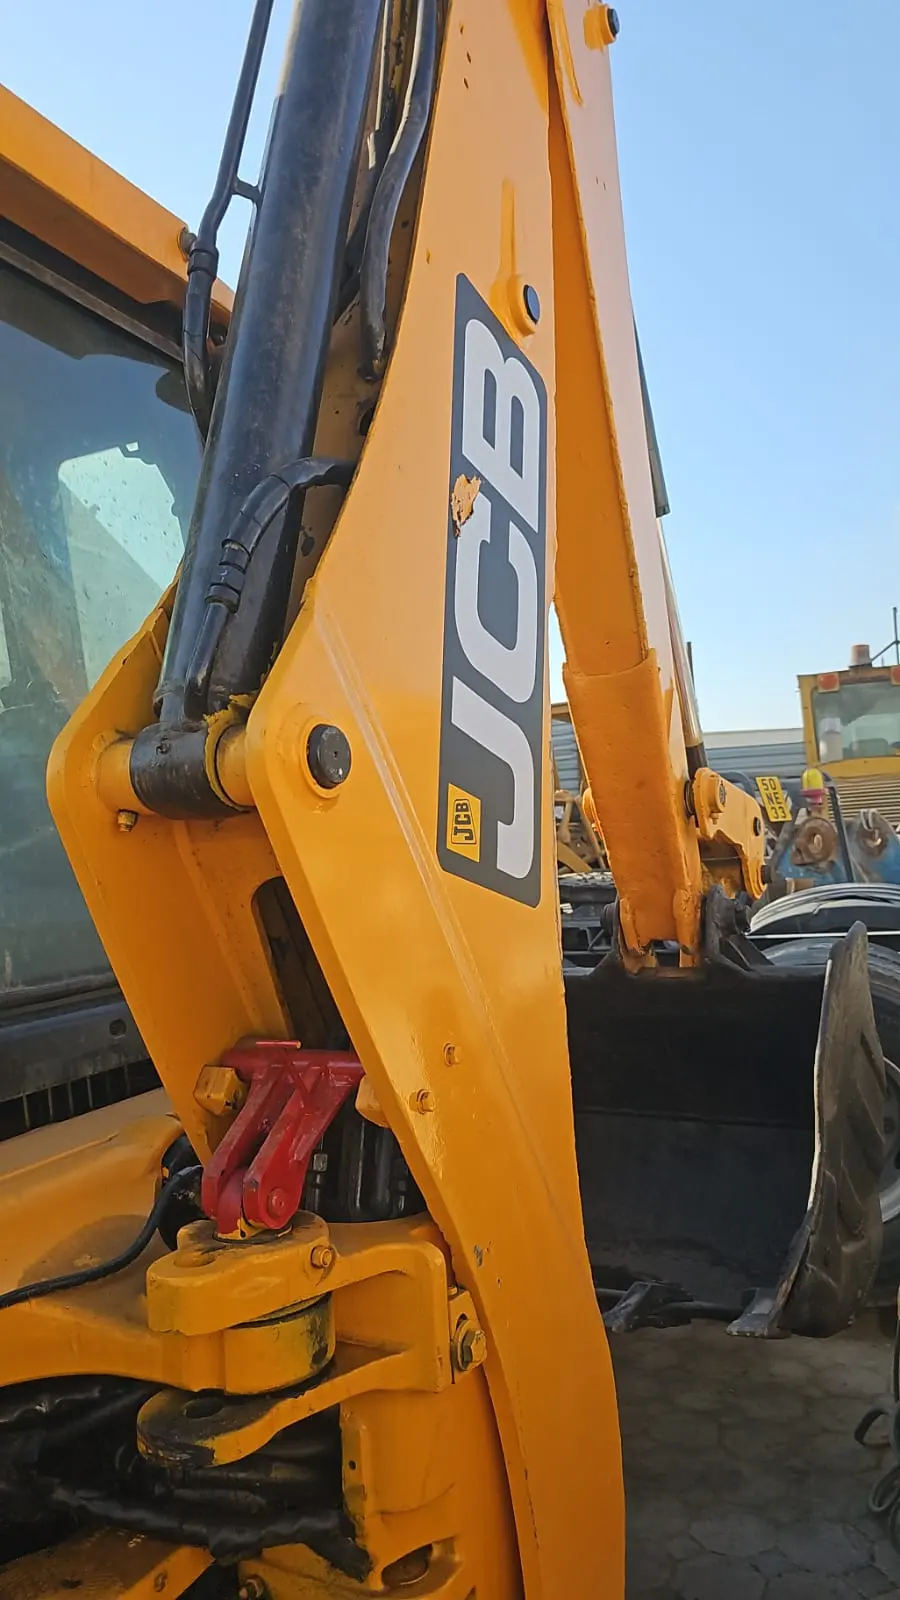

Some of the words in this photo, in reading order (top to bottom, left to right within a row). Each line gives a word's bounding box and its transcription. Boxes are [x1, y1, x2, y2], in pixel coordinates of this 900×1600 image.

[451, 318, 541, 879] JCB
[765, 791, 782, 805] NE
[453, 802, 474, 841] JCB
[771, 806, 787, 819] 33
